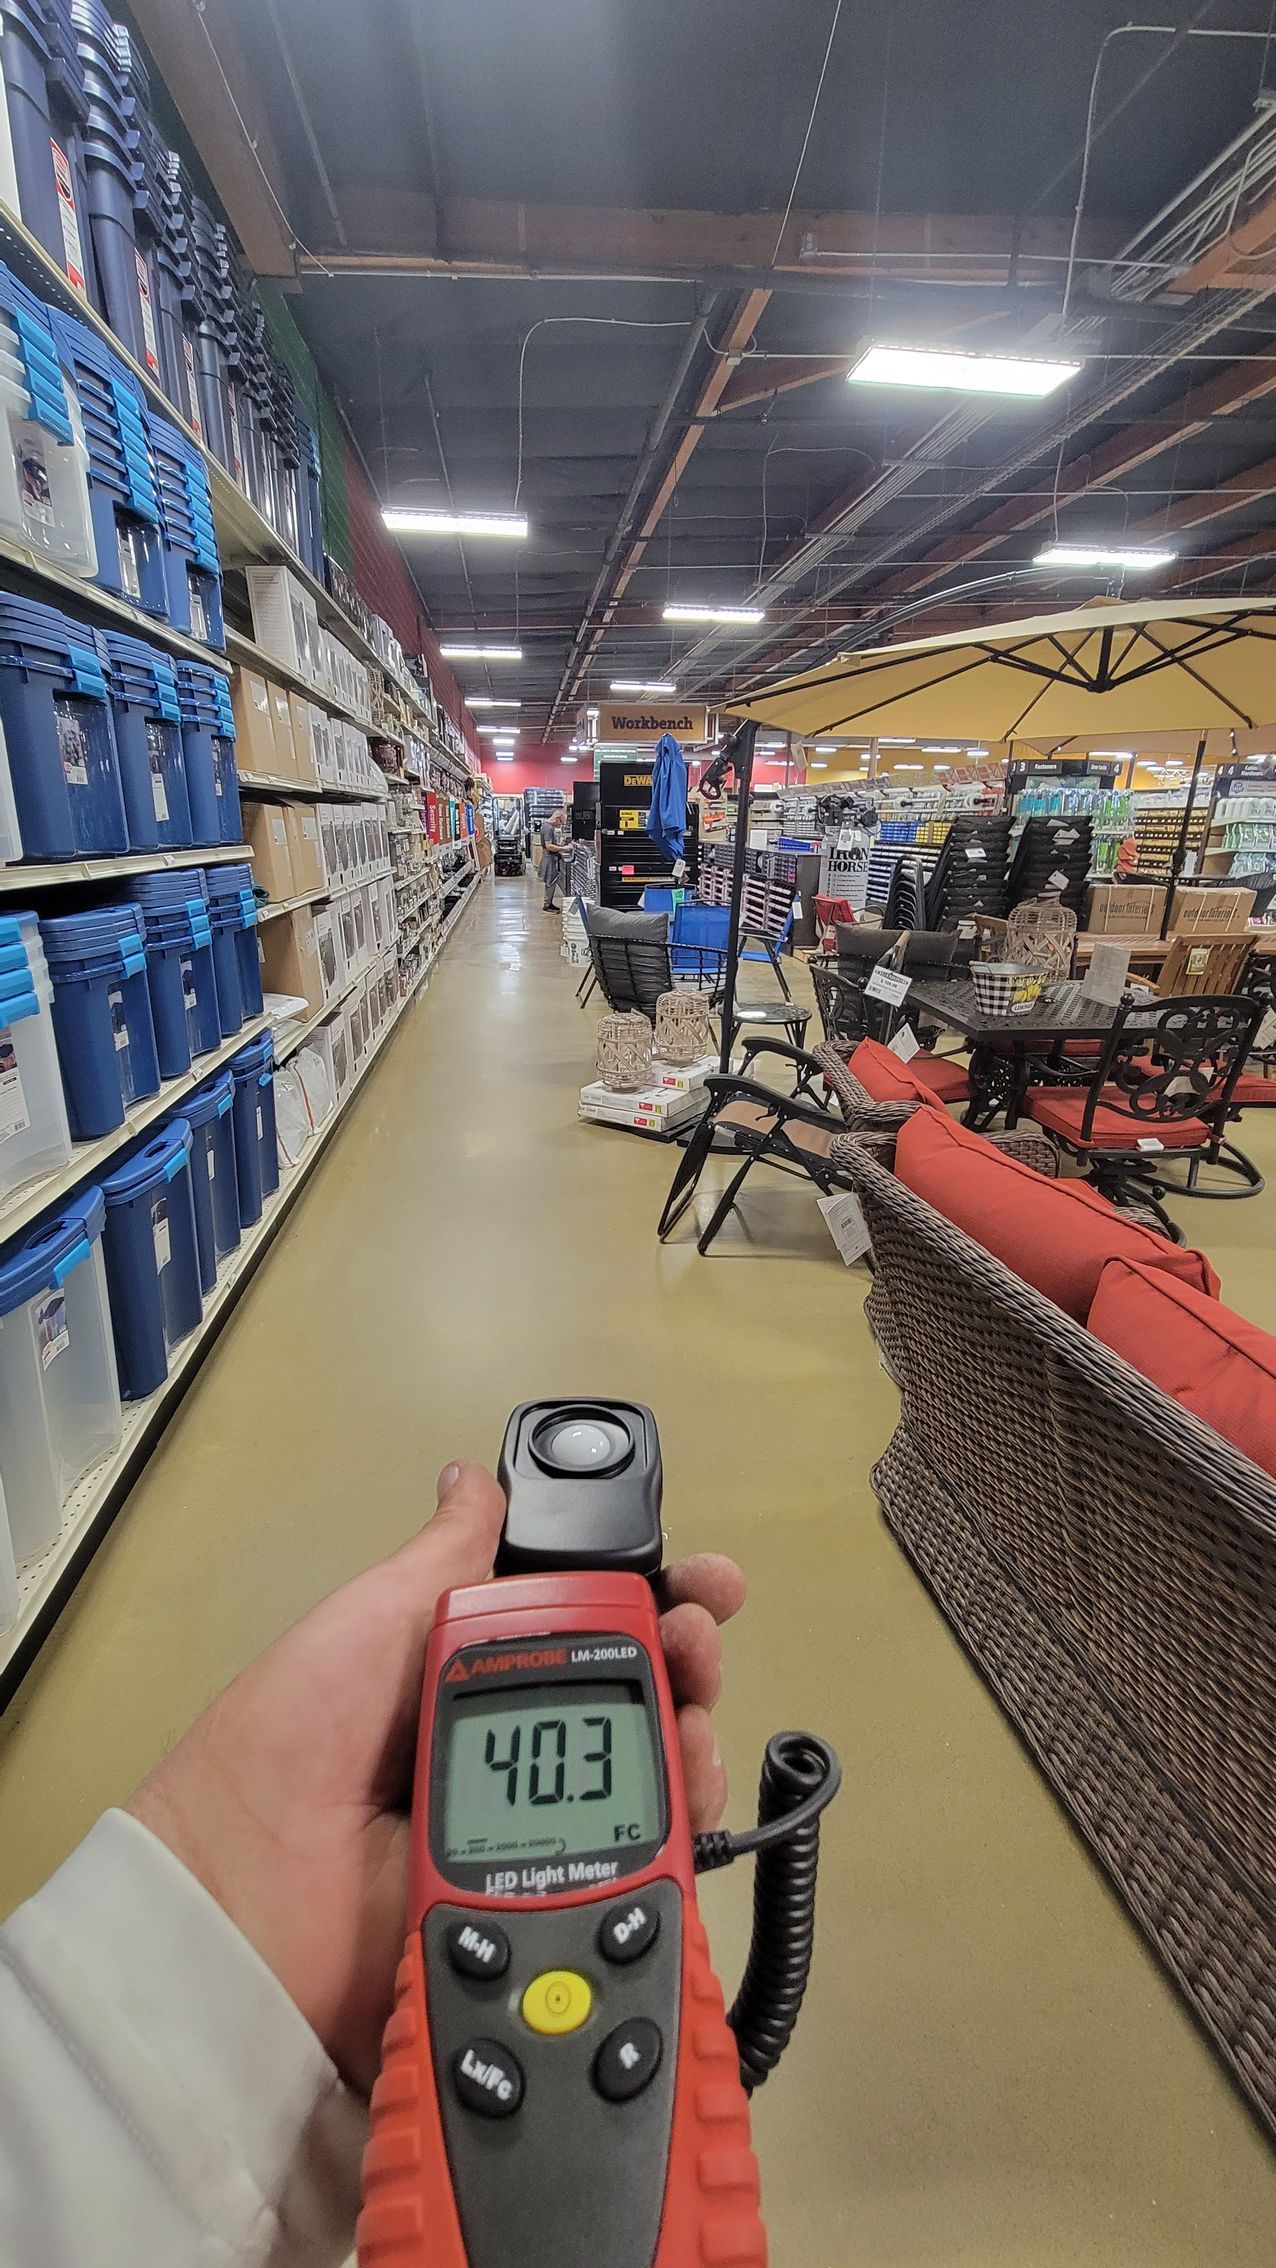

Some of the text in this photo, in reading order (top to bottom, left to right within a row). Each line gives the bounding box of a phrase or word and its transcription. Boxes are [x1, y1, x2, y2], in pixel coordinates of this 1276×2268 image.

[611, 716, 693, 729] Workbench
[624, 776, 652, 786] DEWA
[828, 847, 868, 860] IRON
[828, 861, 868, 872] HORSE
[470, 1647, 637, 1675] AMPROBE LM-200LED
[485, 1717, 612, 1806] 40.3
[614, 1823, 642, 1842] FC
[486, 1861, 619, 1891] LED Light Meter
[613, 1907, 646, 1944] D-H
[458, 1926, 496, 1963] M-H
